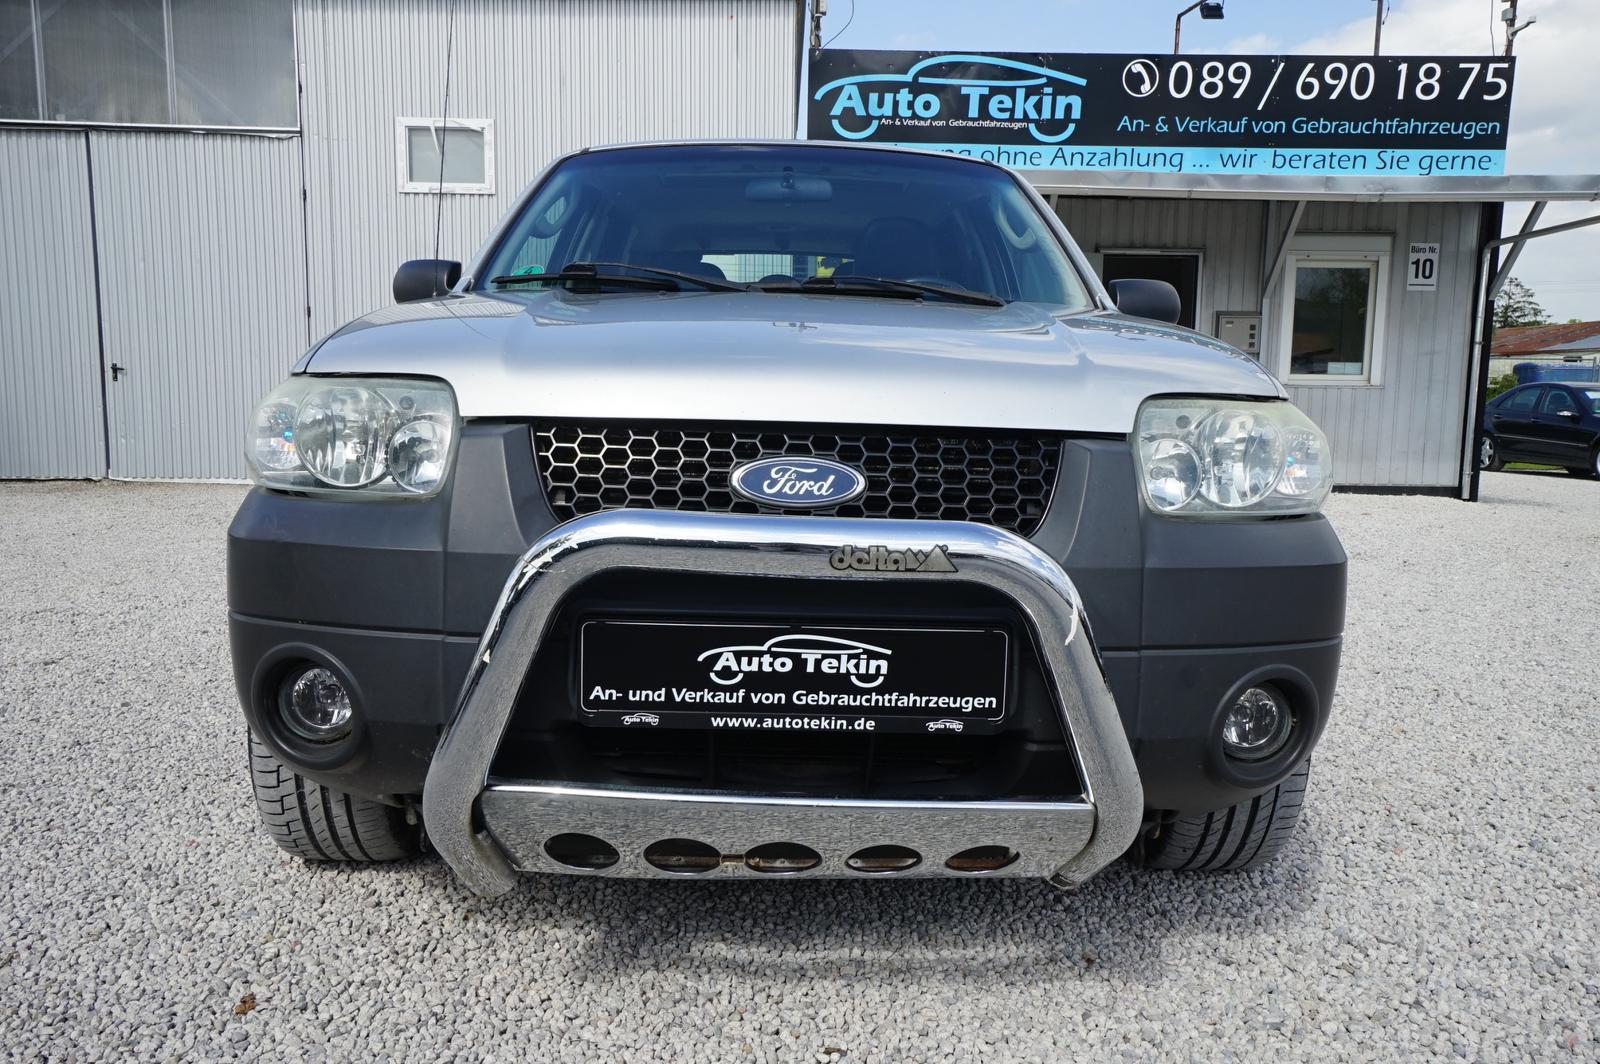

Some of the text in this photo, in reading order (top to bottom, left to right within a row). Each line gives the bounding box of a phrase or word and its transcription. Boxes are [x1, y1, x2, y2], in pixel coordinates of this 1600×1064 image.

[1168, 61, 1251, 99] 089
[1295, 62, 1375, 100] 690
[1397, 63, 1441, 100] 18
[1457, 62, 1510, 101] 75
[829, 85, 1082, 120] Auto Tekin
[903, 118, 931, 127] Verkauf
[949, 119, 1028, 130] Gebrauchtfahrzeugen
[1116, 115, 1500, 140] An- & Verkauf von Gebrauchtfahrzeugen
[981, 146, 1042, 167] ohne
[1050, 147, 1184, 173] Anzahlung
[1219, 149, 1258, 168] wir
[1272, 150, 1367, 171] beraten
[1376, 150, 1410, 171] Sie
[1418, 154, 1492, 177] gerne
[1411, 246, 1427, 254] Büro
[1411, 258, 1434, 280] 10
[763, 465, 836, 497] Ford
[712, 651, 888, 676] Auto Tekin
[589, 685, 998, 712] An- und Verkauf von Gebrauchtfahrzeugen
[710, 715, 876, 731] www.autotekin.de
